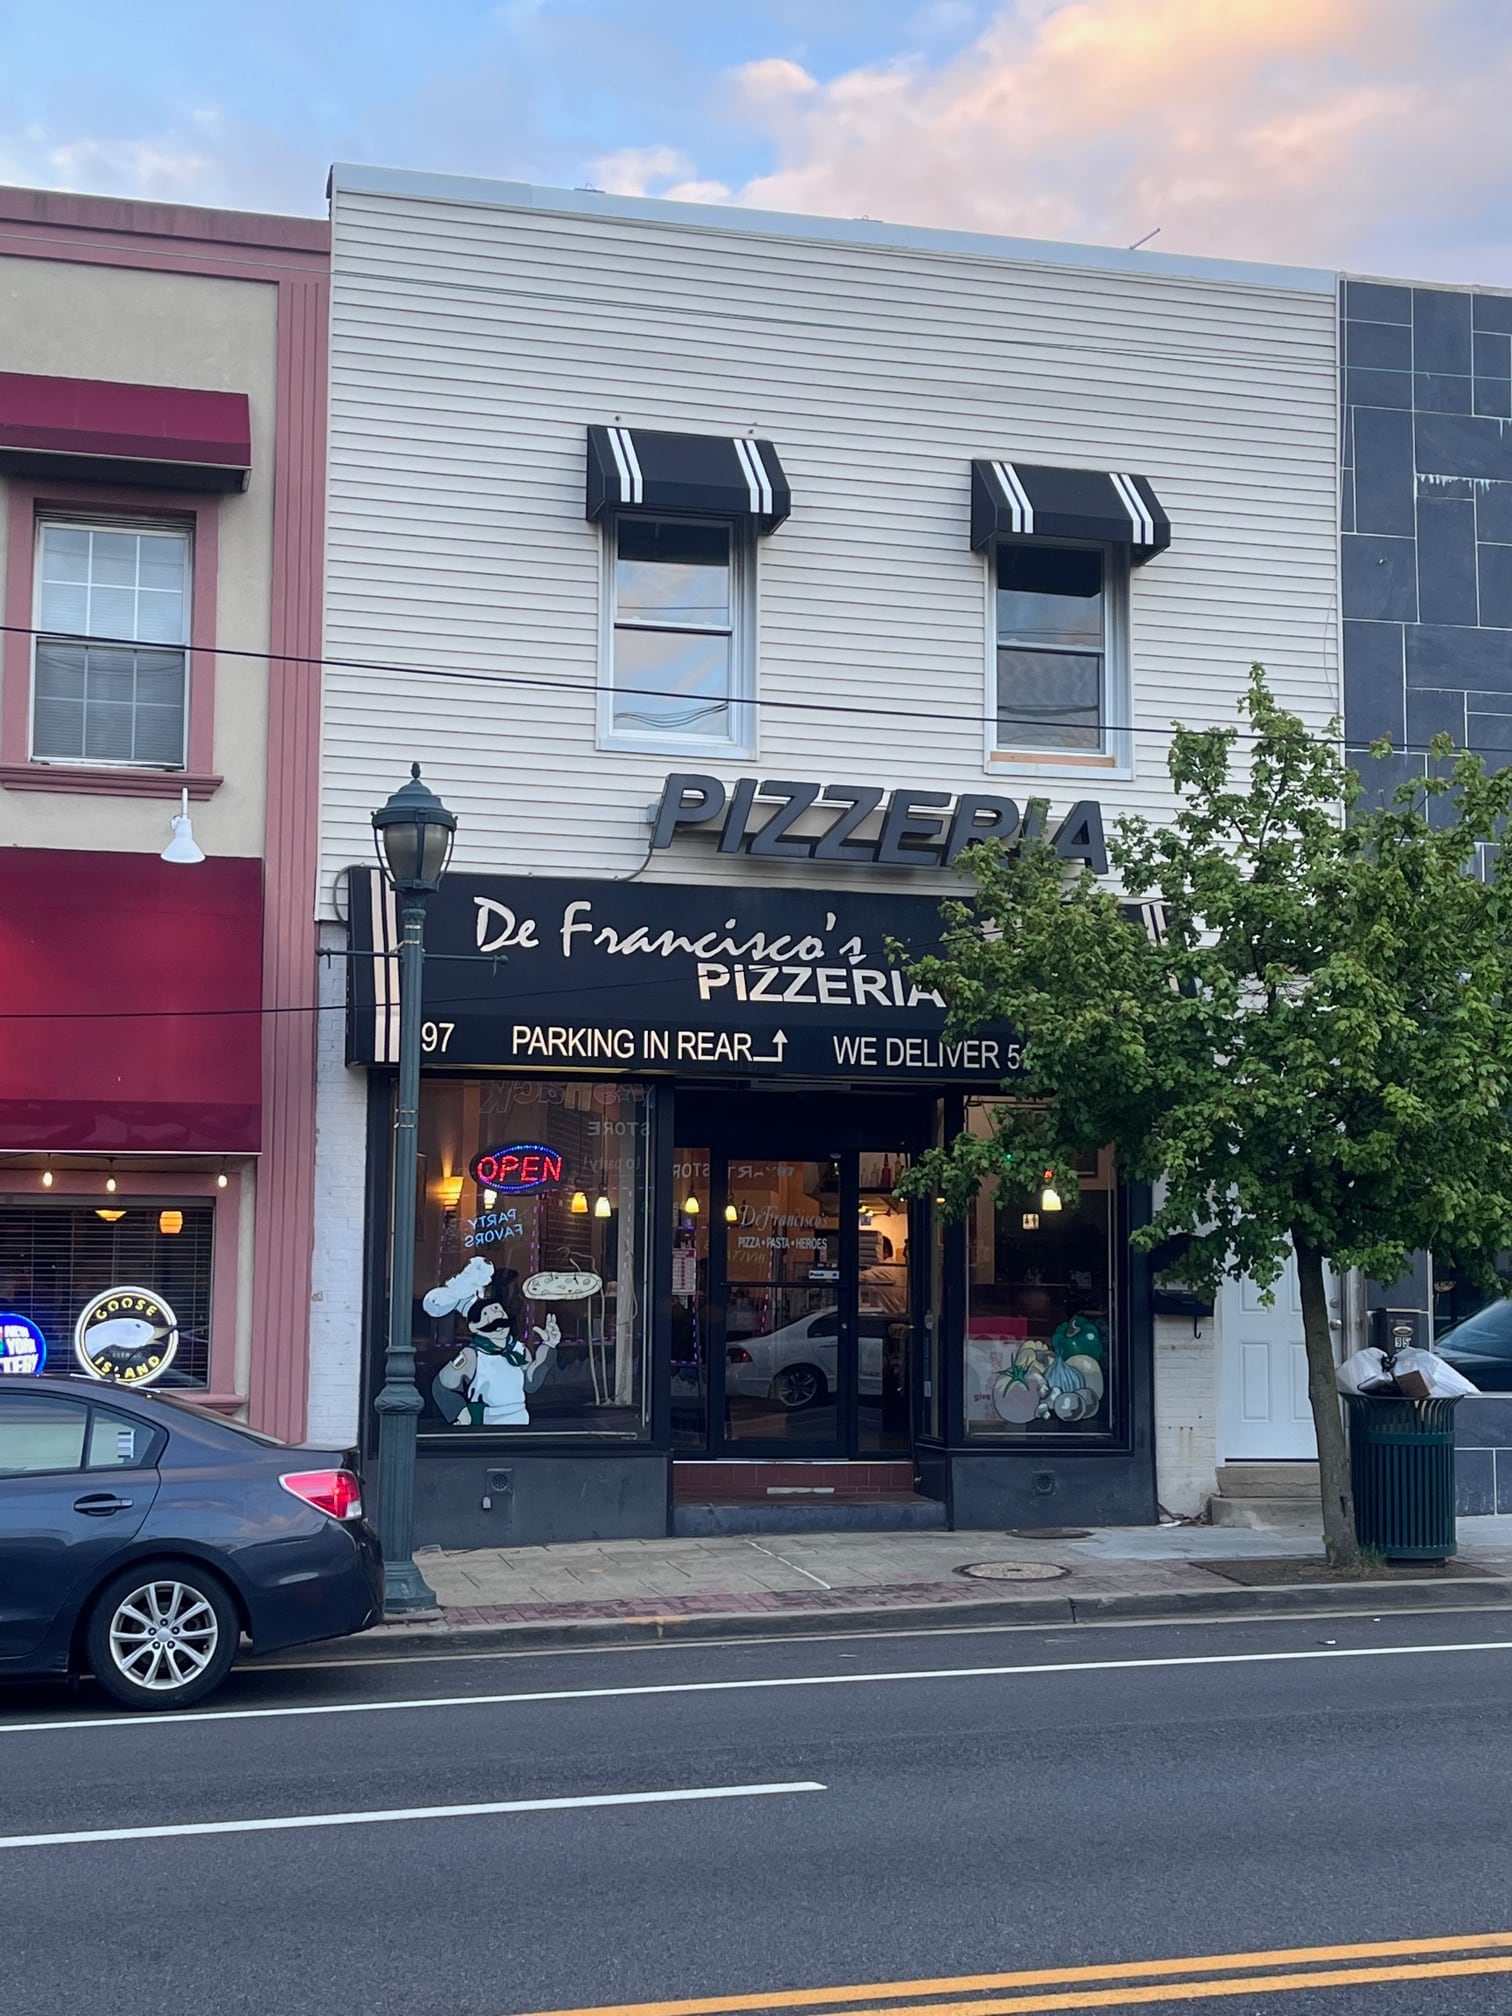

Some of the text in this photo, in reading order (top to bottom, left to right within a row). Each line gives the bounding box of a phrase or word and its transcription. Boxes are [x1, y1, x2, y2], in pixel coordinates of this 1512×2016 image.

[649, 773, 1108, 874] PIZZERIA
[474, 896, 867, 965] De Francisco's
[697, 962, 947, 1008] PIZZERIA
[421, 1022, 455, 1052] 97
[512, 1025, 634, 1059] PARKING
[643, 1030, 669, 1060] IN
[677, 1031, 752, 1062] REAR
[833, 1035, 877, 1066] WE
[885, 1037, 1000, 1069] DELIVER
[476, 1155, 563, 1182] OPEN
[738, 1236, 828, 1250] PIZZA PASTA HEROES
[95, 1297, 158, 1319] GOOSE
[95, 1356, 160, 1379] ISLAND
